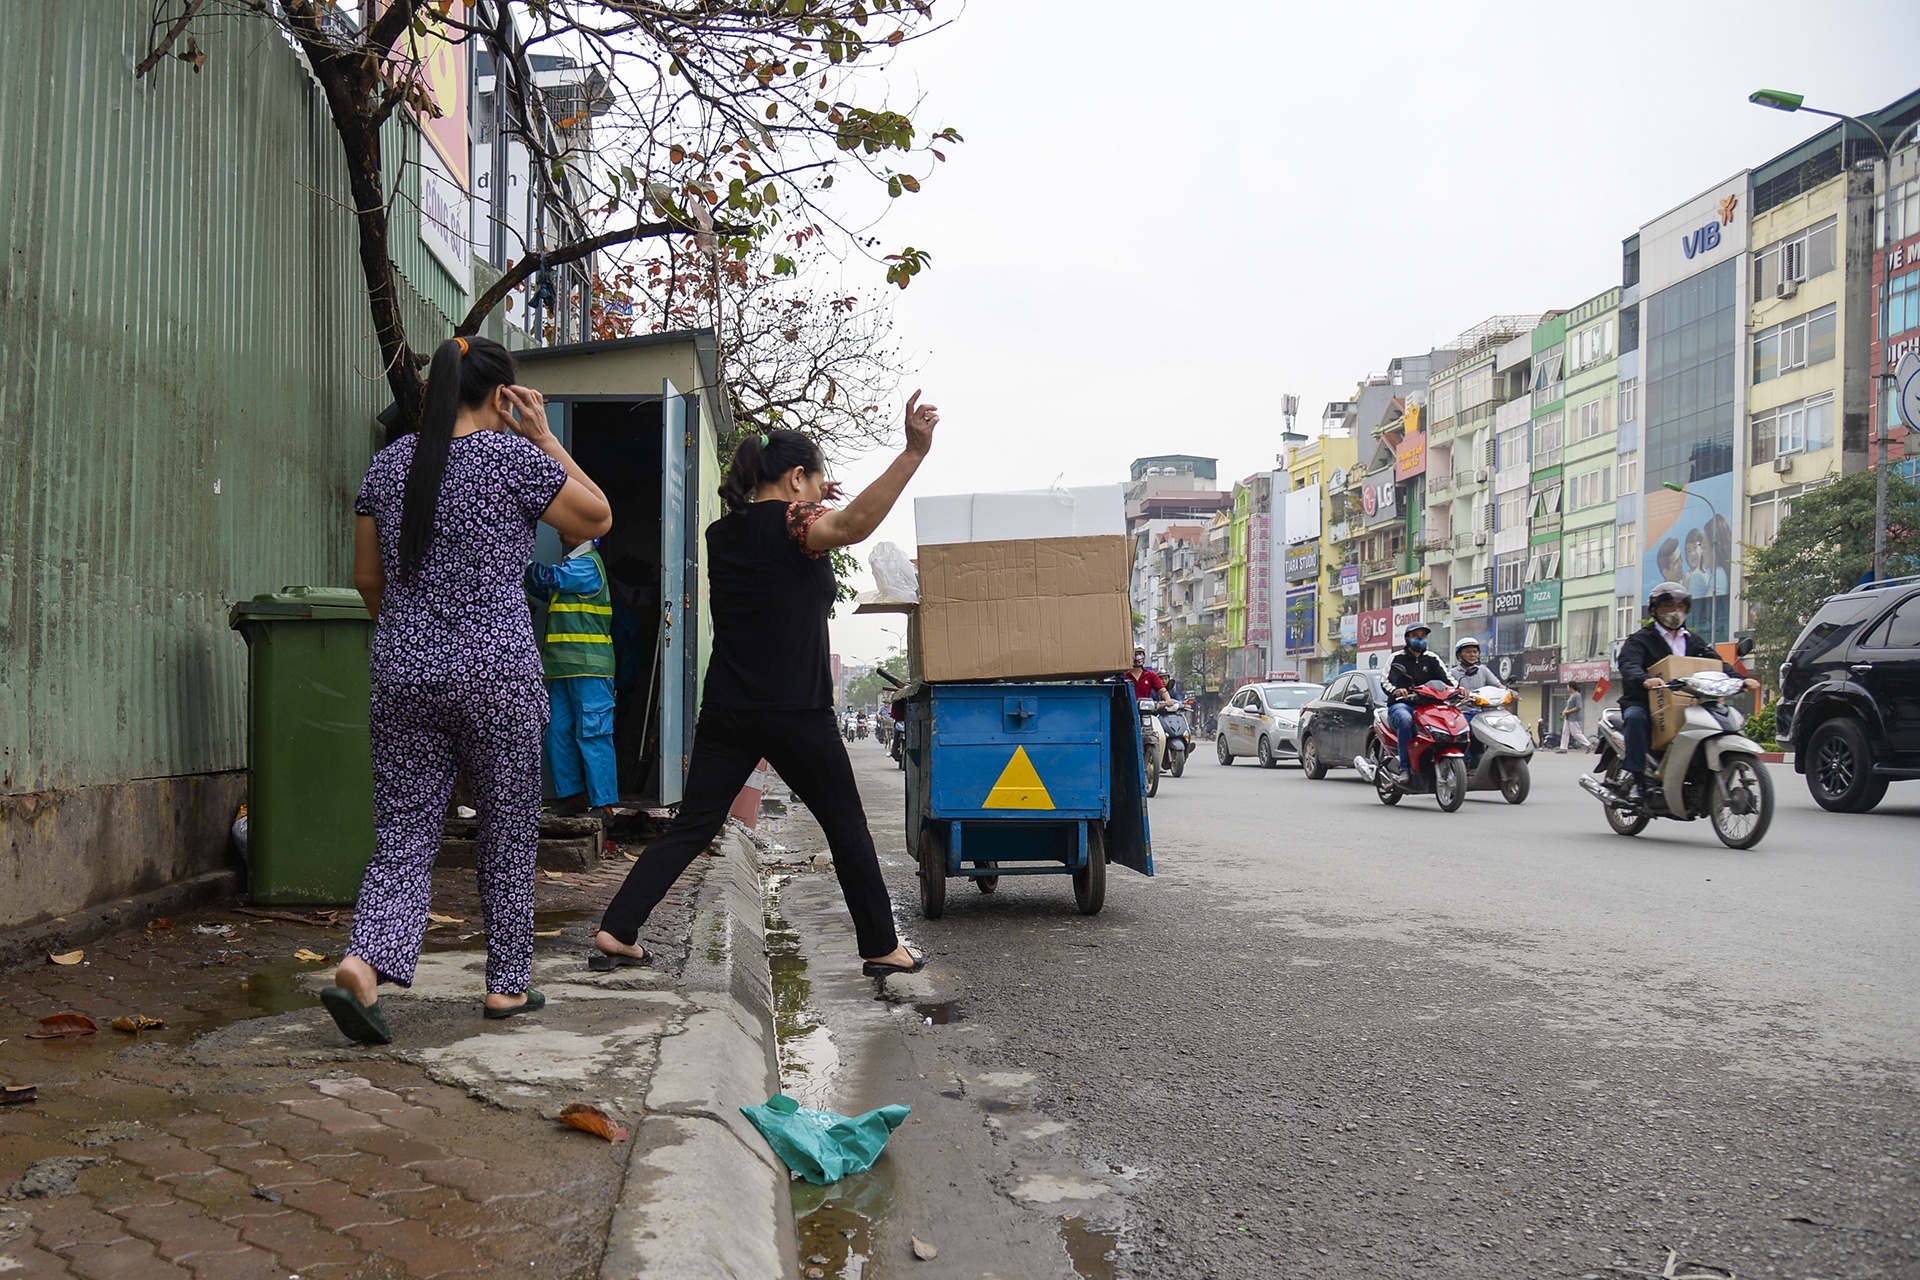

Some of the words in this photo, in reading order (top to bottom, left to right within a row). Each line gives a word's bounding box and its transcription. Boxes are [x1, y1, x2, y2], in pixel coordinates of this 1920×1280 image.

[463, 230, 467, 267] 1
[1682, 221, 1721, 259] VIB
[1377, 482, 1394, 508] LG
[1285, 558, 1299, 574] TIARA
[1299, 553, 1317, 570] STUDIO
[1258, 566, 1268, 624] SALON
[1495, 593, 1522, 613] peem
[1533, 591, 1551, 602] PIZZA
[1372, 617, 1387, 637] LG
[1394, 612, 1420, 627] Canon
